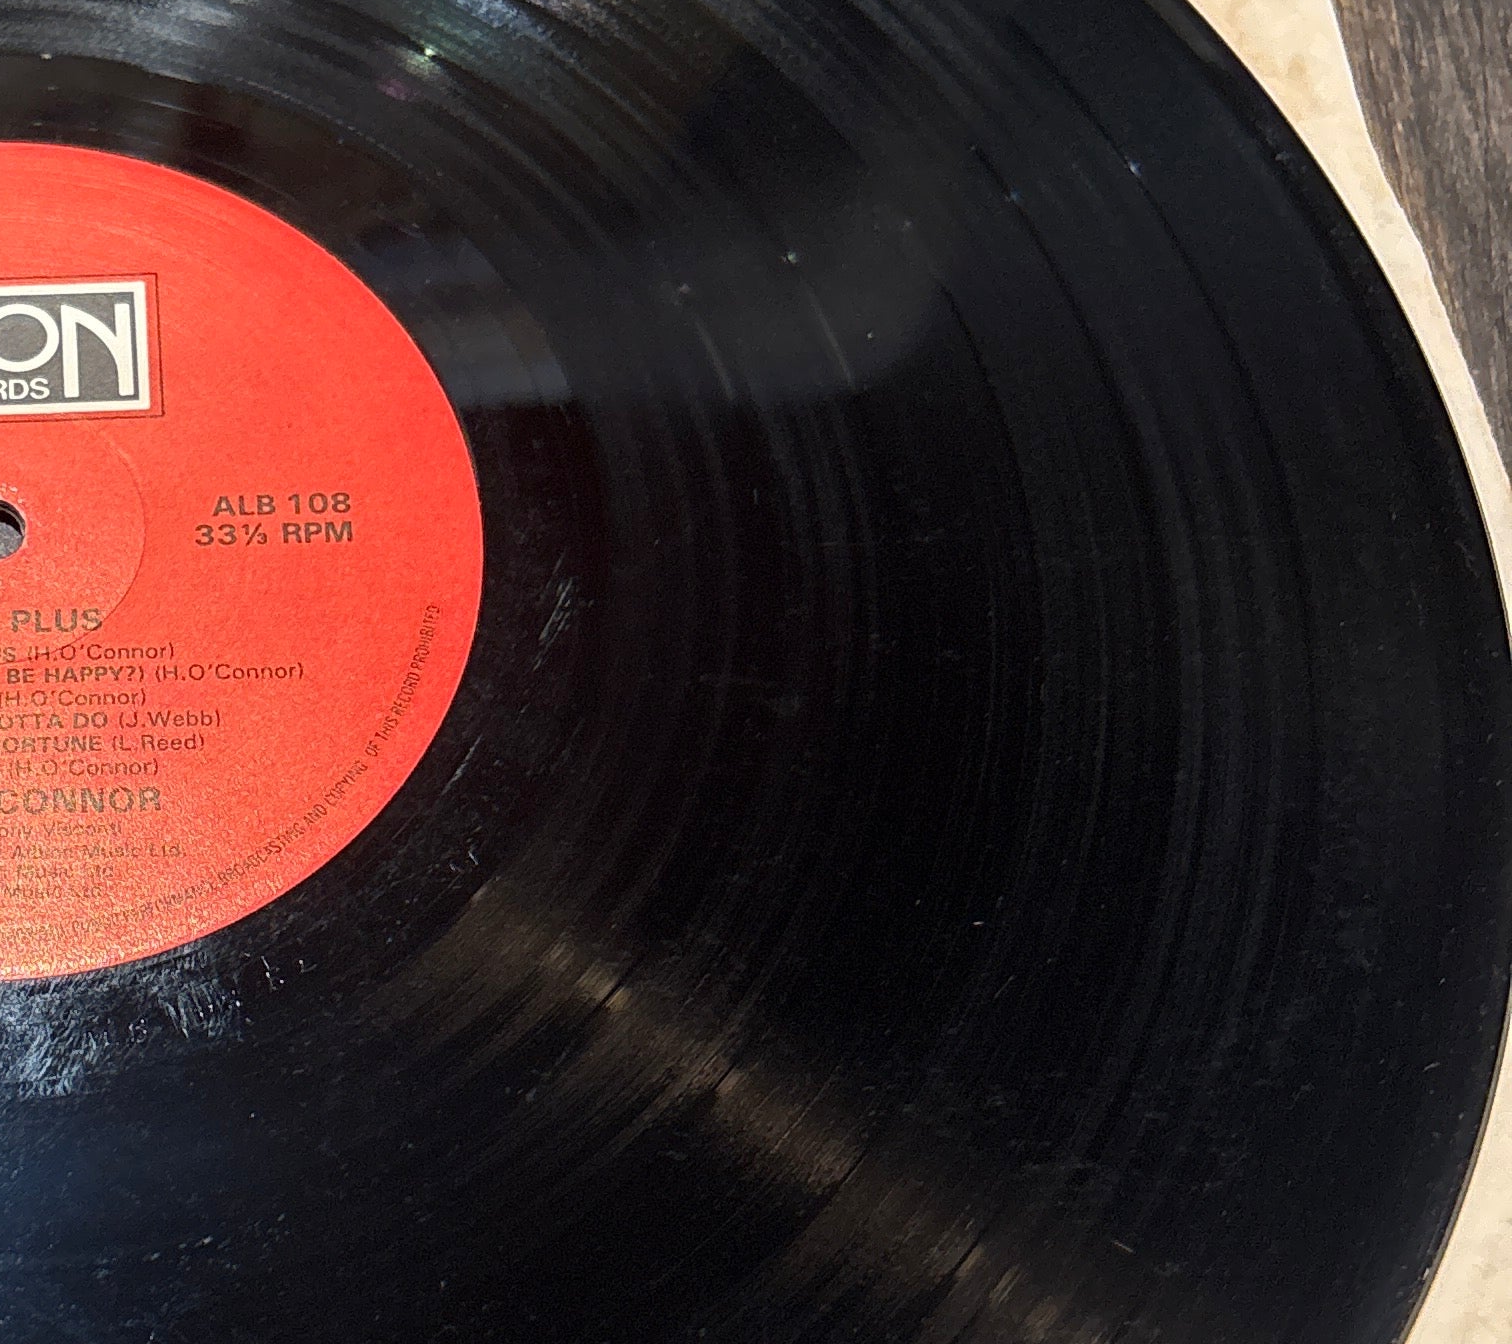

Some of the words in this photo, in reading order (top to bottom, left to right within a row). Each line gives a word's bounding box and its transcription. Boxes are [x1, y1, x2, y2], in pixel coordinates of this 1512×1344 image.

[212, 494, 276, 516] ALB
[287, 492, 351, 515] 108
[282, 520, 353, 544] RPM
[10, 607, 104, 634] PLUS
[26, 642, 175, 664] (H.O'Connor)
[6, 667, 34, 684] BE
[44, 665, 146, 683] HAPPY?)
[155, 662, 305, 682] (H.O'Connor)
[364, 739, 382, 757] OF
[374, 716, 399, 740] THIS
[390, 671, 421, 717] RECORD
[411, 605, 441, 672] PROHIBITED
[73, 711, 108, 729] DO
[118, 709, 221, 729] (J.Webb)
[112, 733, 206, 753] (L.Reed)
